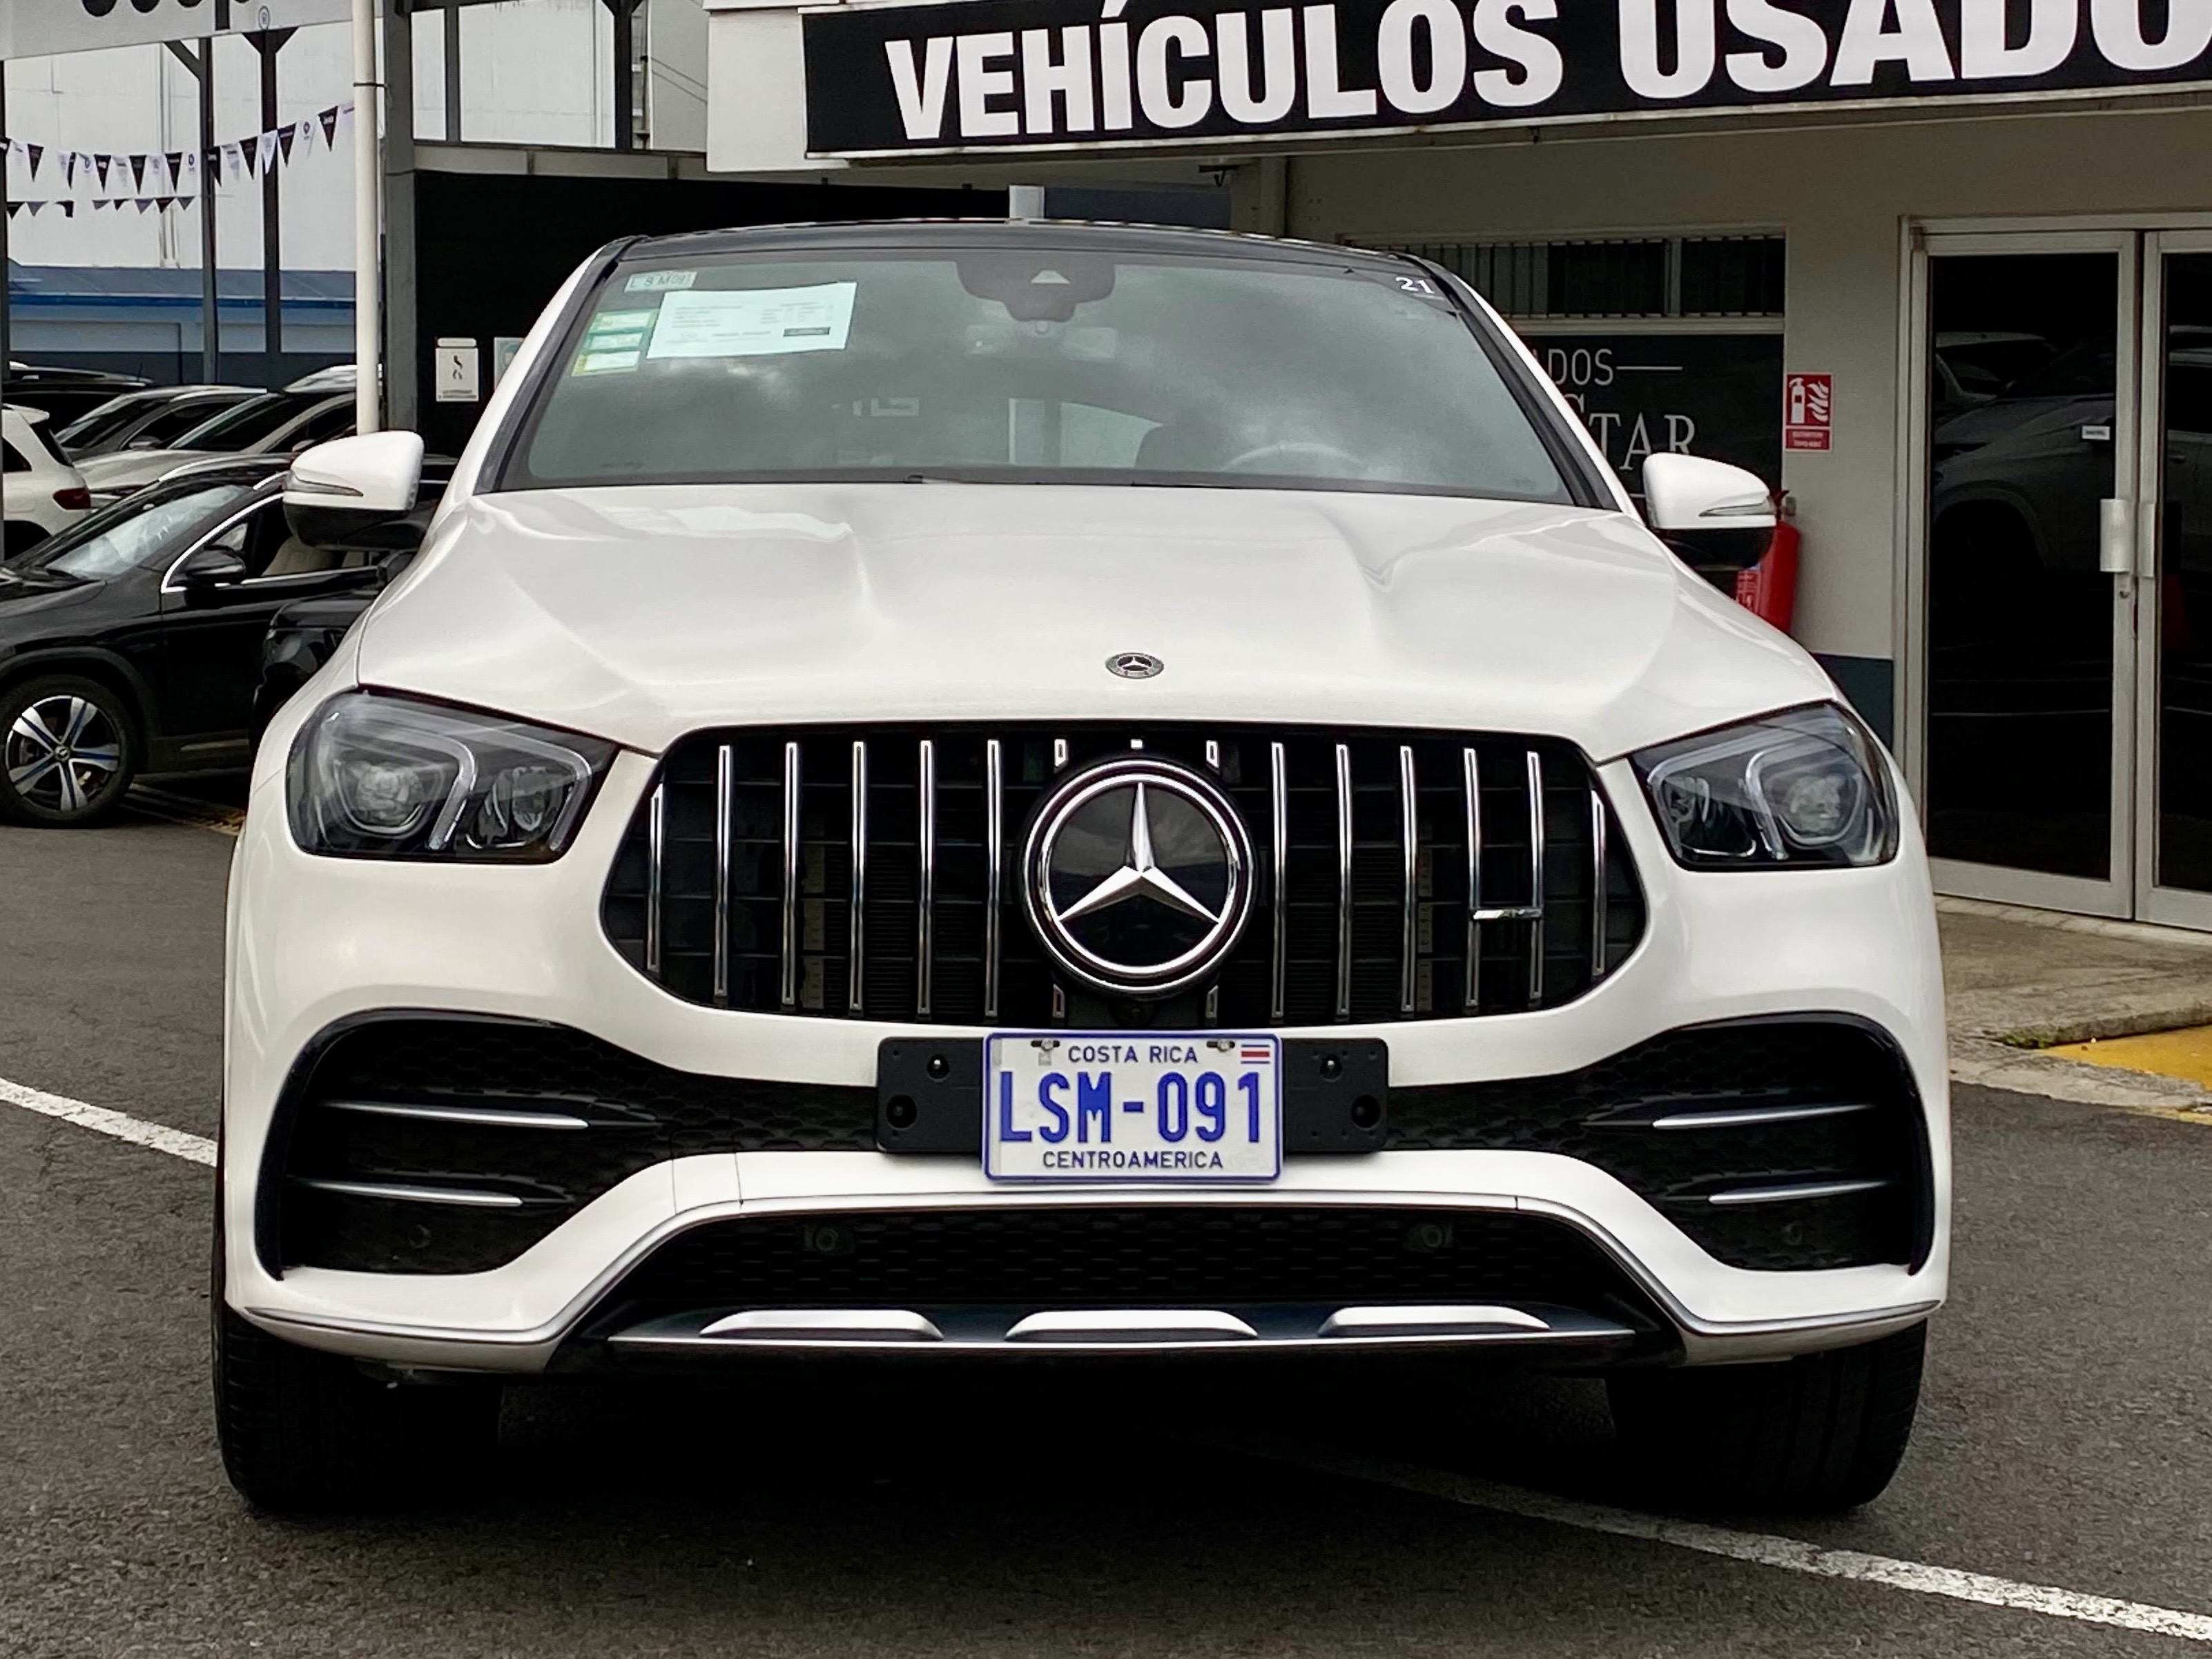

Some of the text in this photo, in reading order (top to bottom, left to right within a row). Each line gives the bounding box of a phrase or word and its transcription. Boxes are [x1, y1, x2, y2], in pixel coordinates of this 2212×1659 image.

[886, 0, 1562, 139] VEHÍCULOS
[1395, 277, 1435, 293] 21
[1533, 349, 1613, 386] DOS
[1564, 393, 1696, 470] TAR
[1068, 1045, 1198, 1063] COSTA RICA
[999, 1071, 1260, 1143] LSM-091
[1042, 1151, 1223, 1169] CENTROAMERICA
